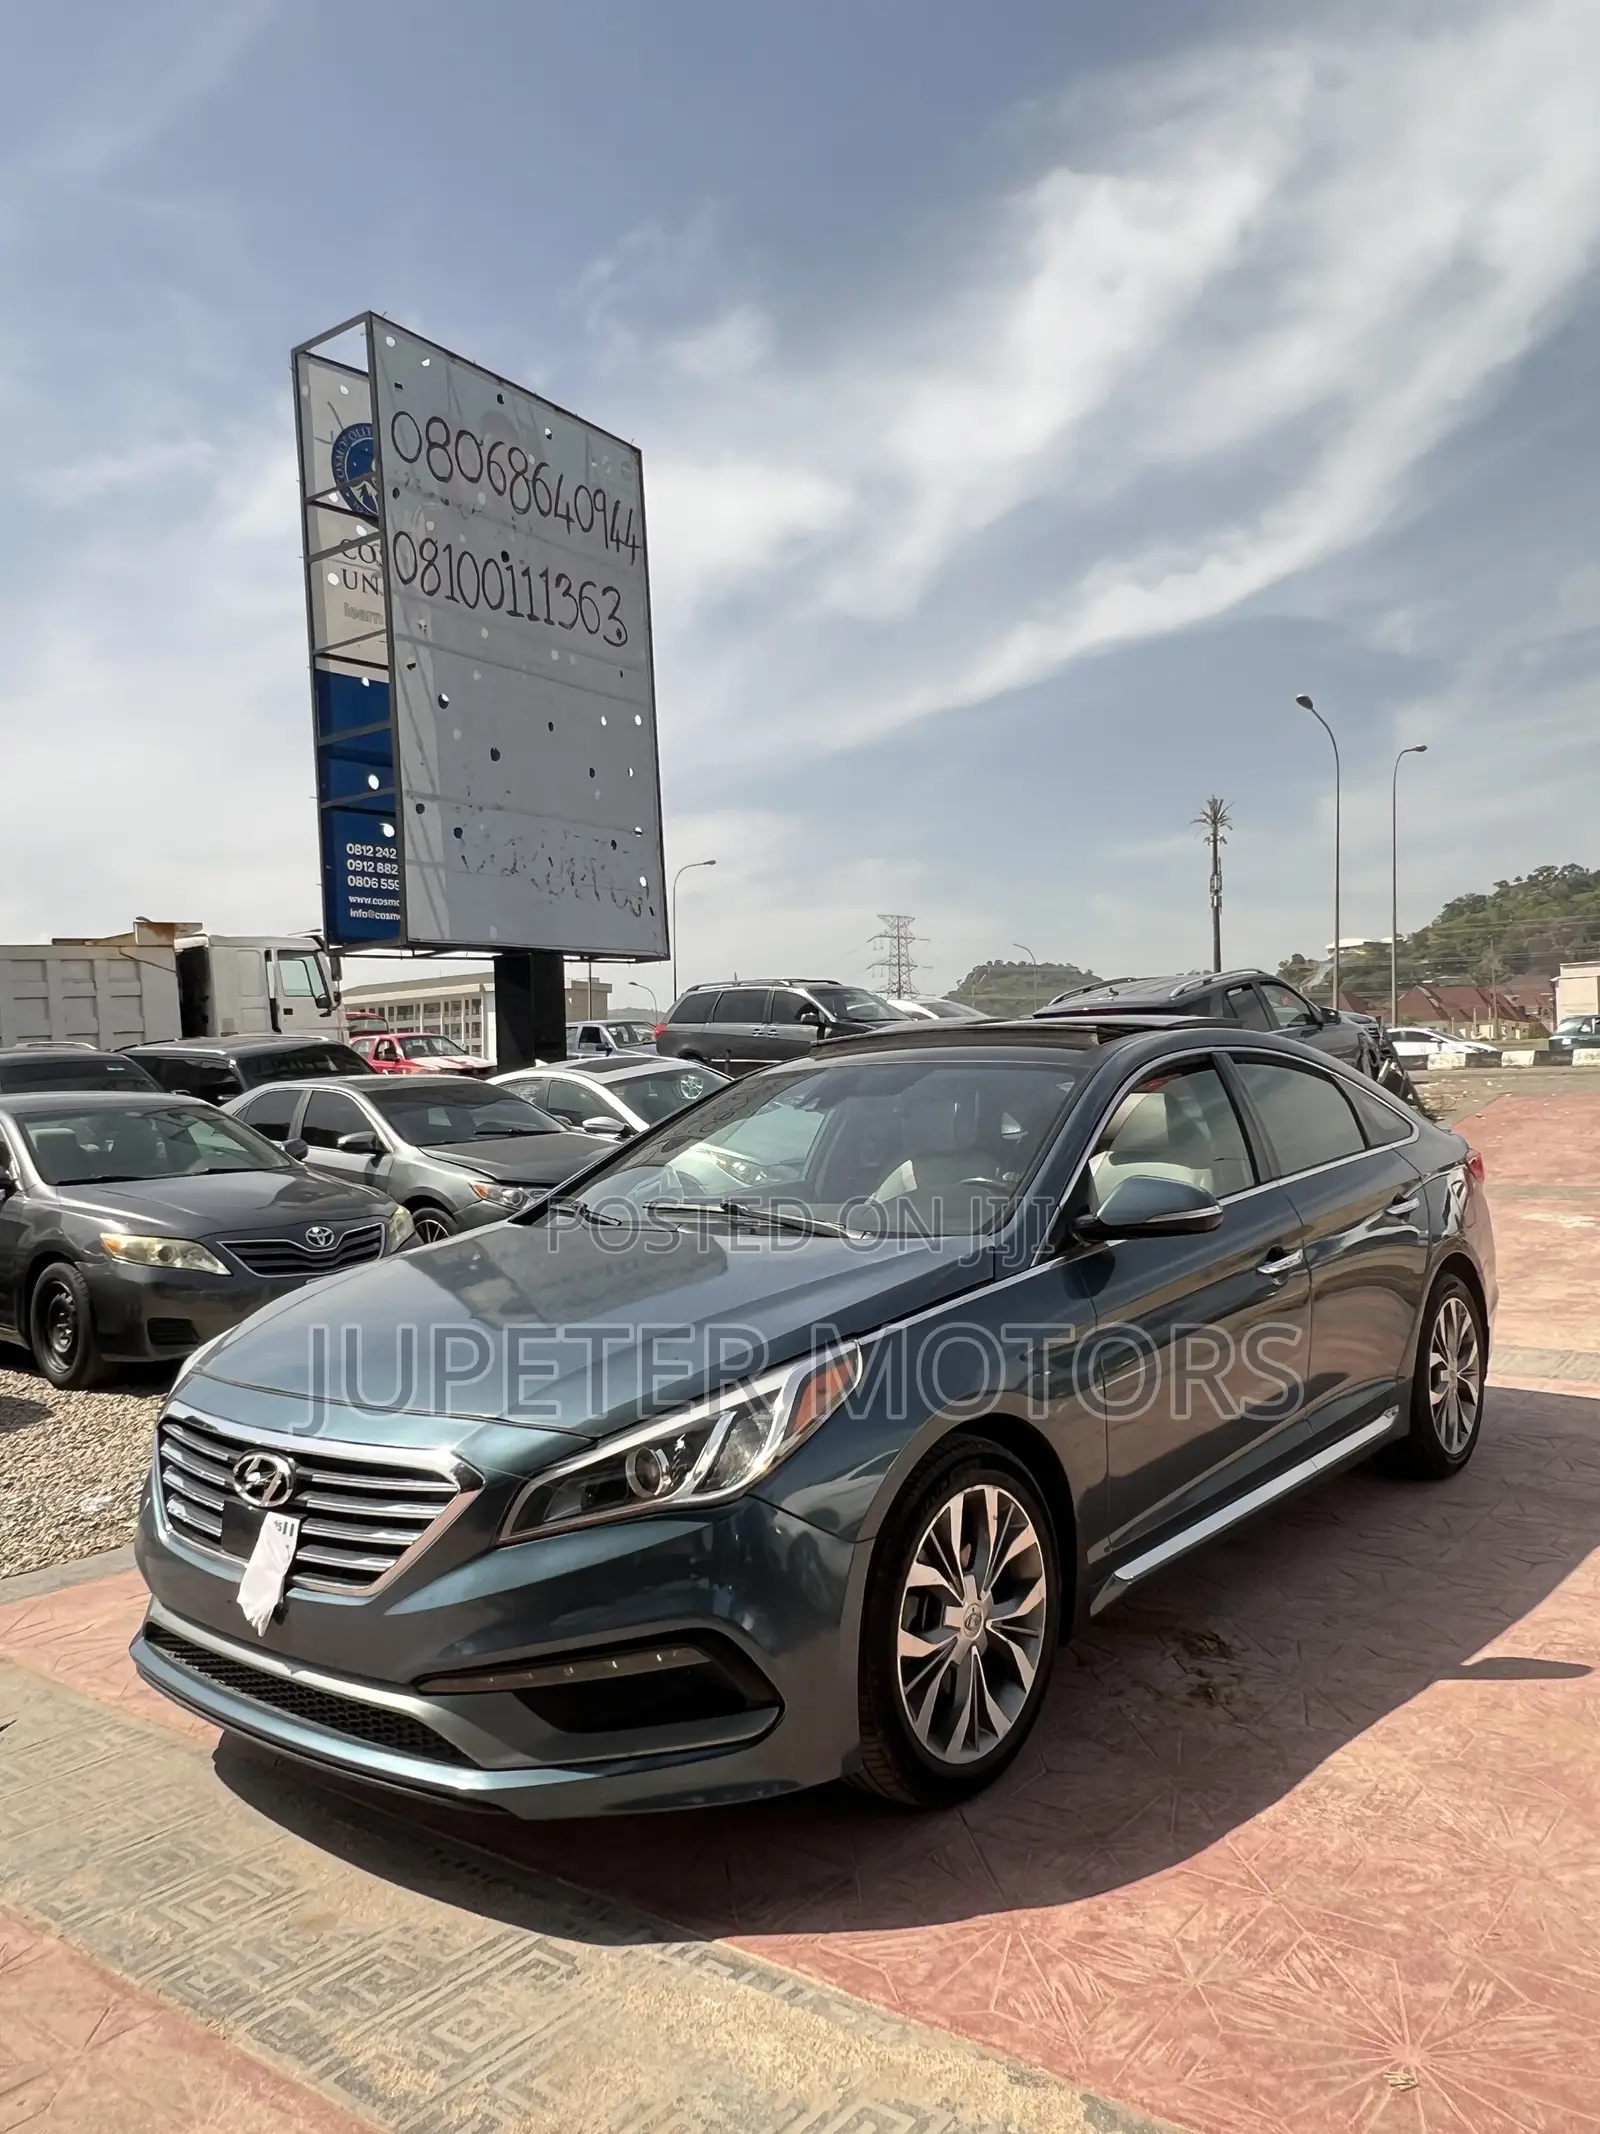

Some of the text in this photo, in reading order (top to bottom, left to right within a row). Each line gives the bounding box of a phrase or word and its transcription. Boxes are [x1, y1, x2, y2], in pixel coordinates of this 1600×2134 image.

[391, 410, 641, 566] 08068640944
[393, 530, 629, 648] 08100111363
[346, 843, 397, 859] 0812 242
[347, 859, 399, 875] 0912 882
[347, 875, 379, 889] 0806
